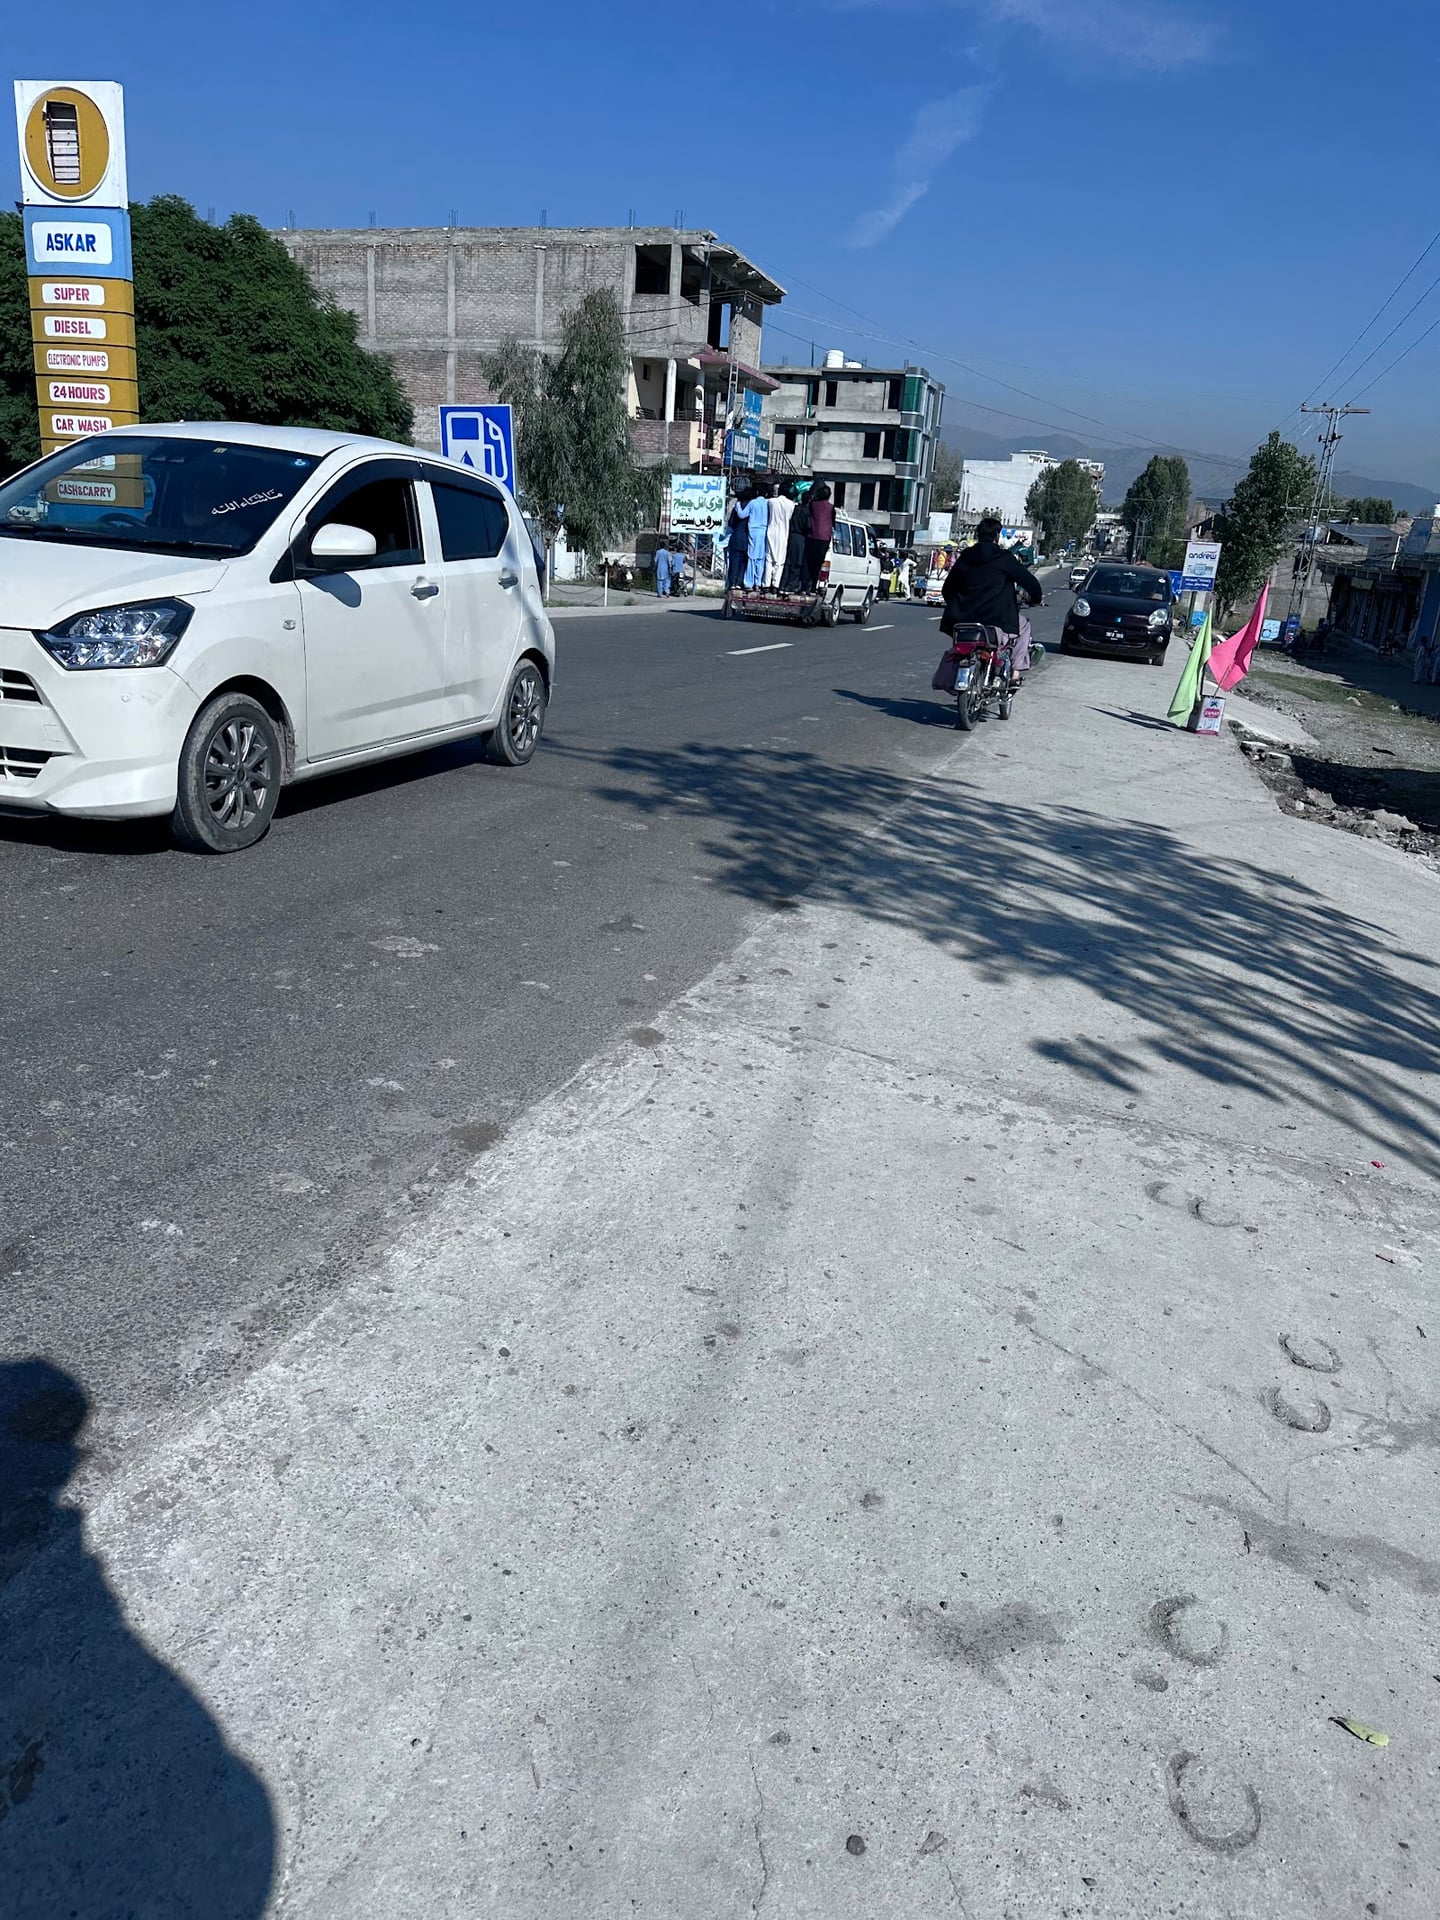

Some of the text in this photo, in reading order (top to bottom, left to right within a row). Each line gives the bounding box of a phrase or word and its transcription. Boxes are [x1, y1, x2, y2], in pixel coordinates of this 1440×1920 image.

[46, 233, 96, 252] ASKAR
[54, 287, 90, 301] SUPER
[54, 320, 91, 334] DIESEL
[48, 353, 106, 367] ELECTRONIC PUMPS
[55, 418, 107, 432] CAR WASH
[59, 484, 112, 497] CASH&CARRY
